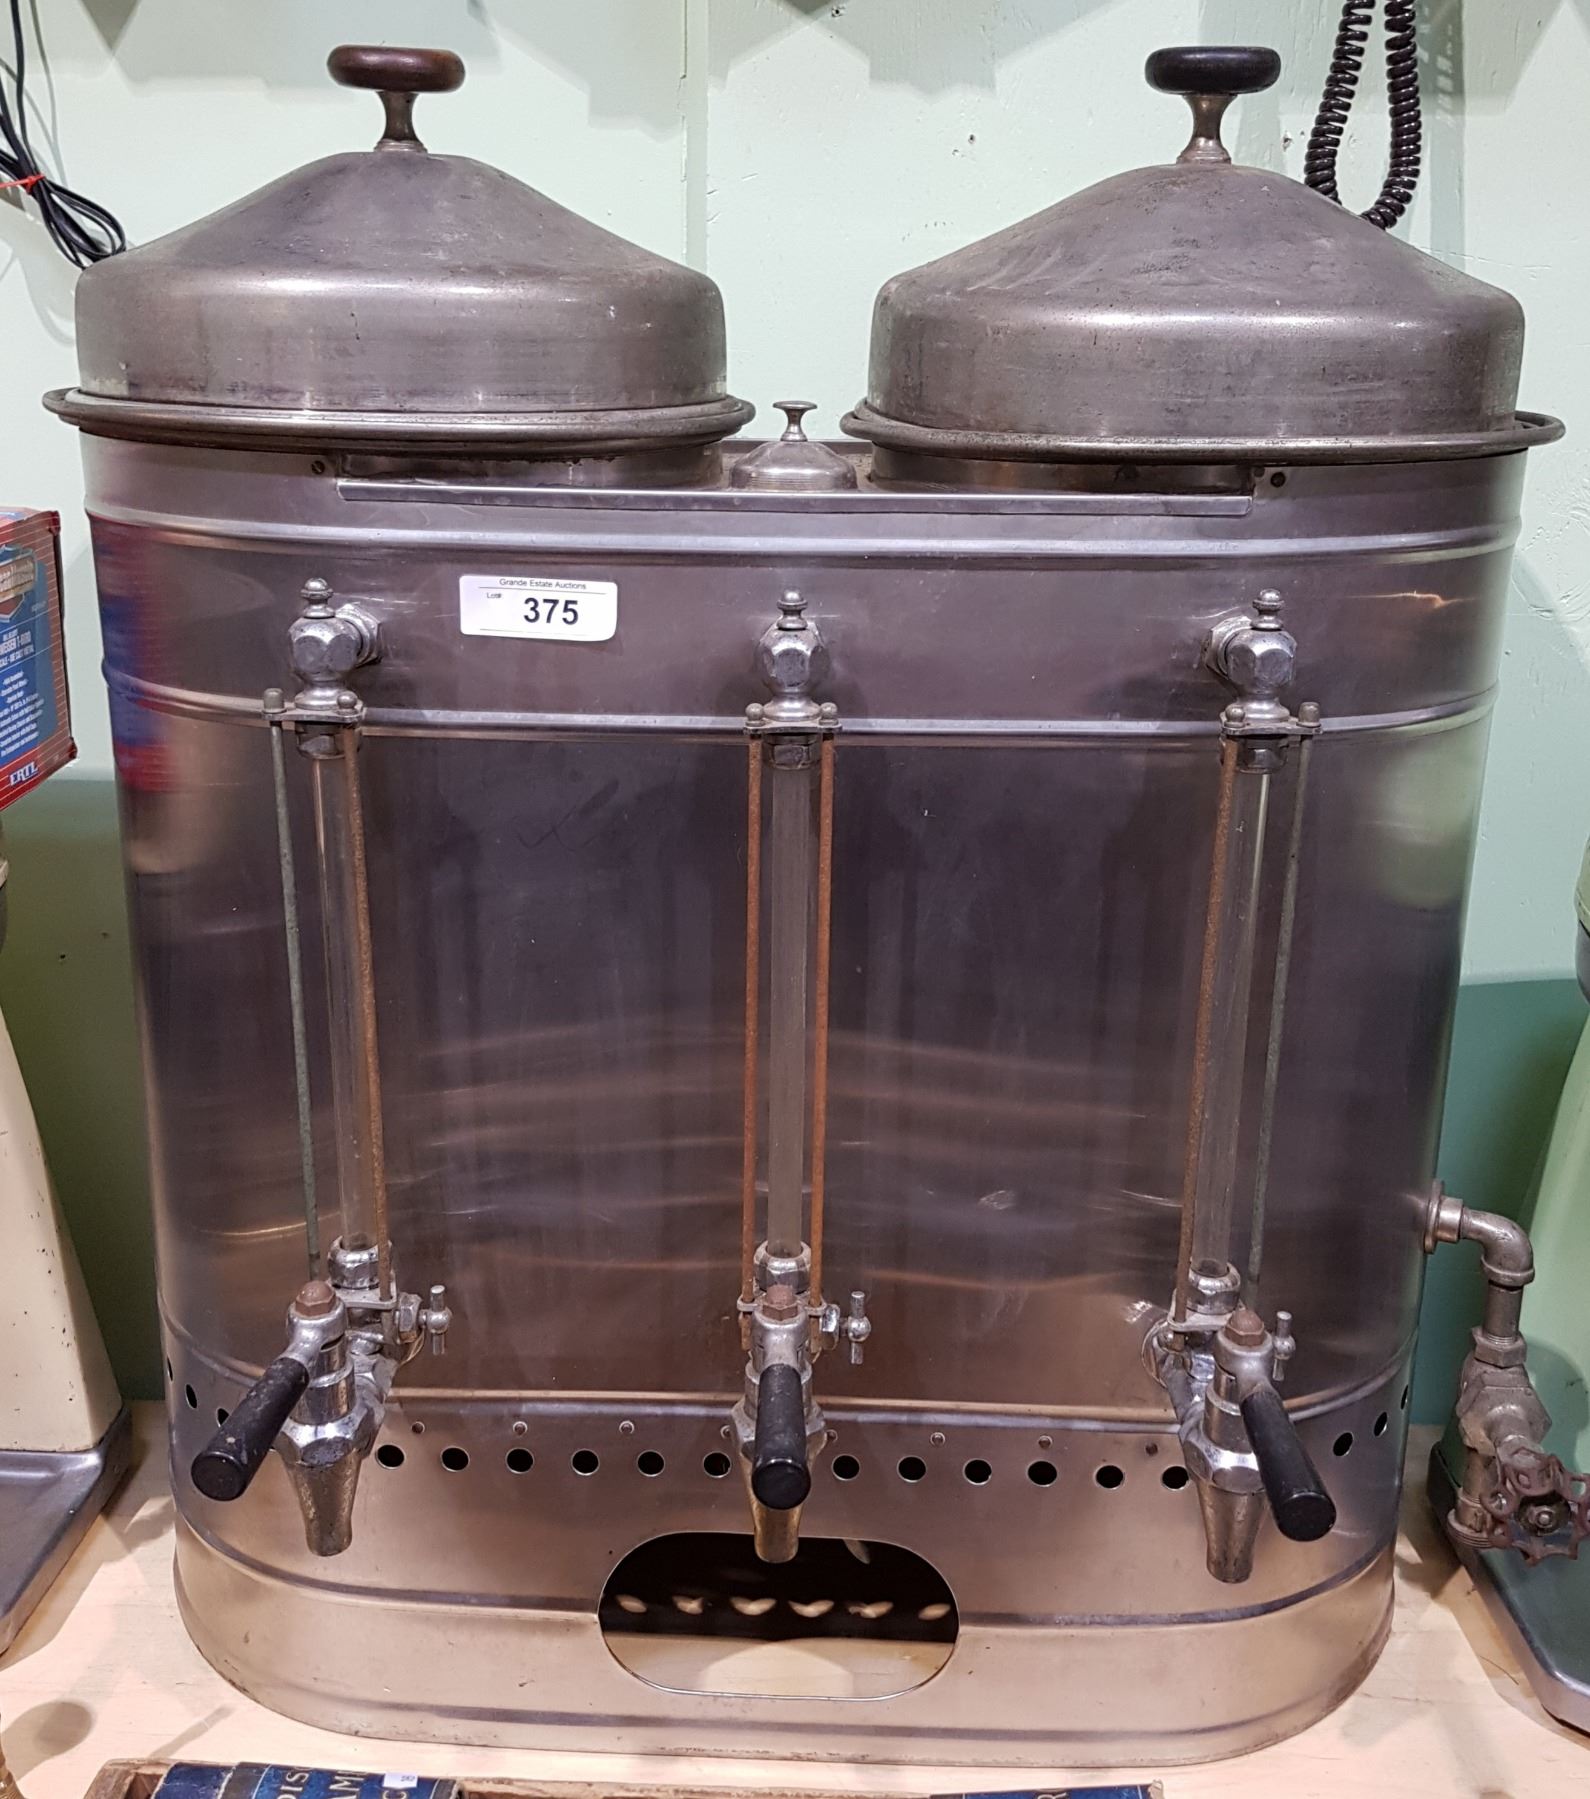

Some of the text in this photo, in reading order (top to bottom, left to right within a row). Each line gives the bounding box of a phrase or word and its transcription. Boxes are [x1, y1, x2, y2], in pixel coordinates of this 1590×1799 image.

[499, 578, 587, 590] Grande Estate Auctions
[523, 597, 579, 625] 375
[10, 762, 38, 786] ERTL
